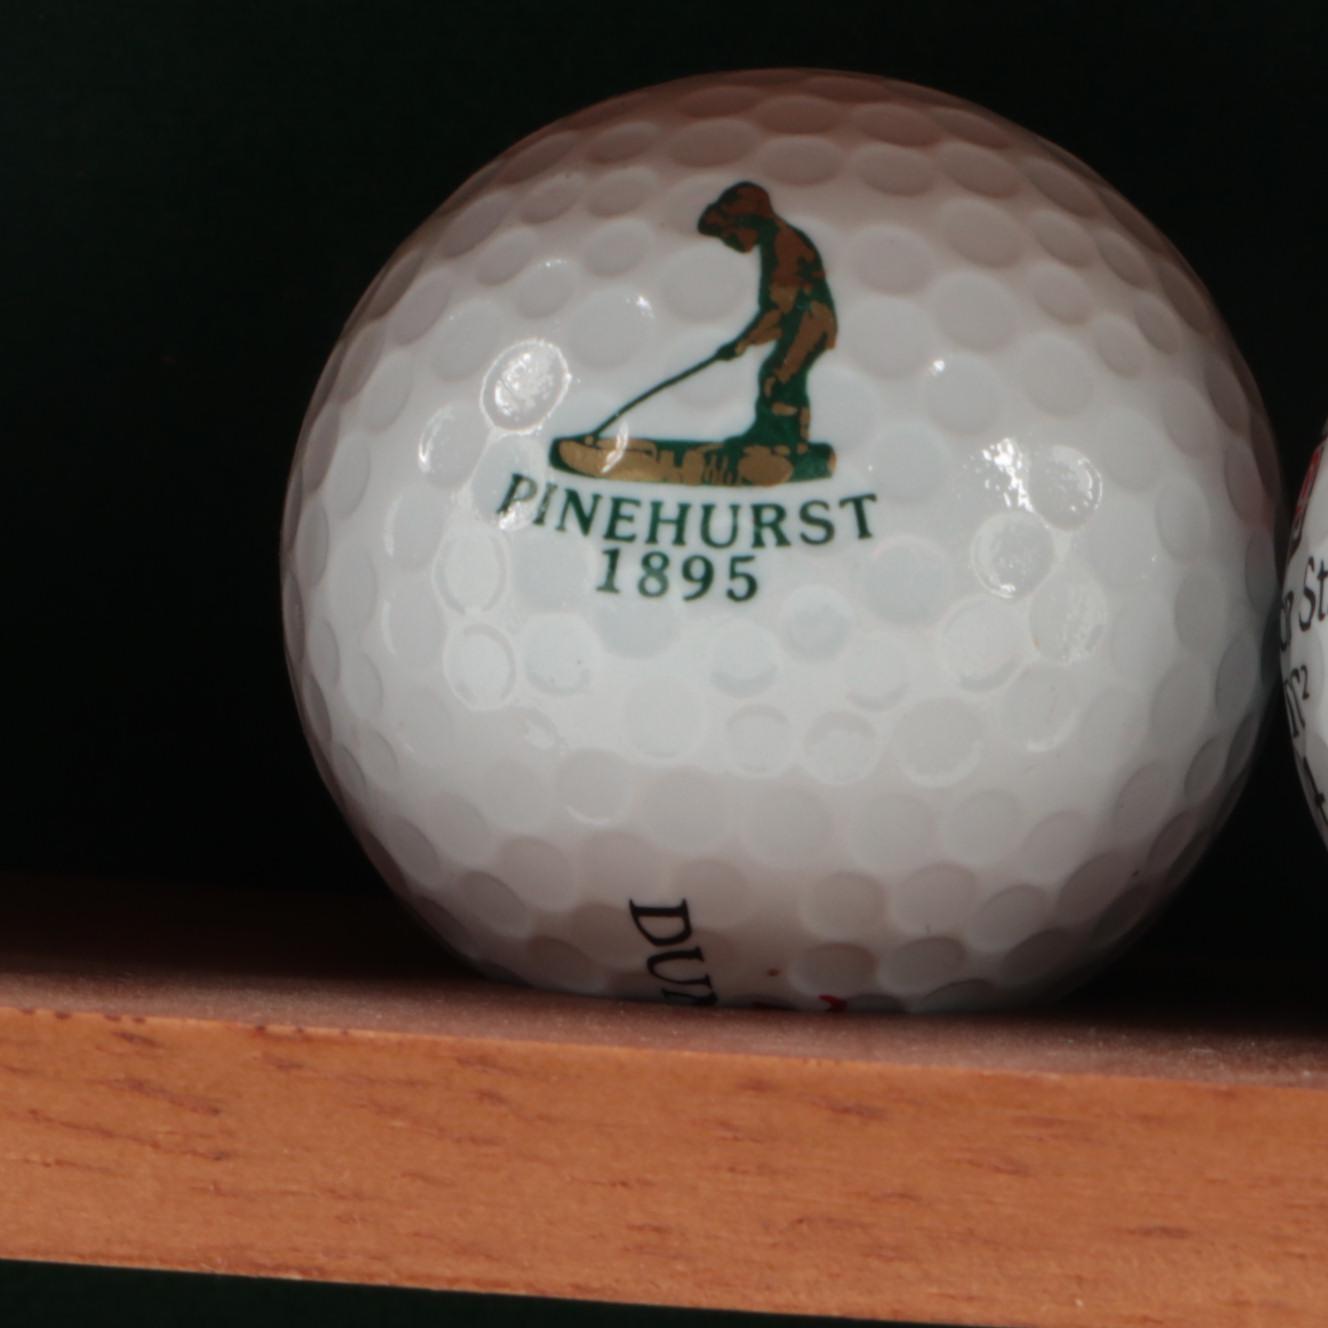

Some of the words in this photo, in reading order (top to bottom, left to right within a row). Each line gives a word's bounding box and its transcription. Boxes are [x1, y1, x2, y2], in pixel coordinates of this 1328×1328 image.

[496, 473, 877, 549] PINEHURST
[595, 548, 759, 602] 1895
[628, 898, 718, 1006] DU
